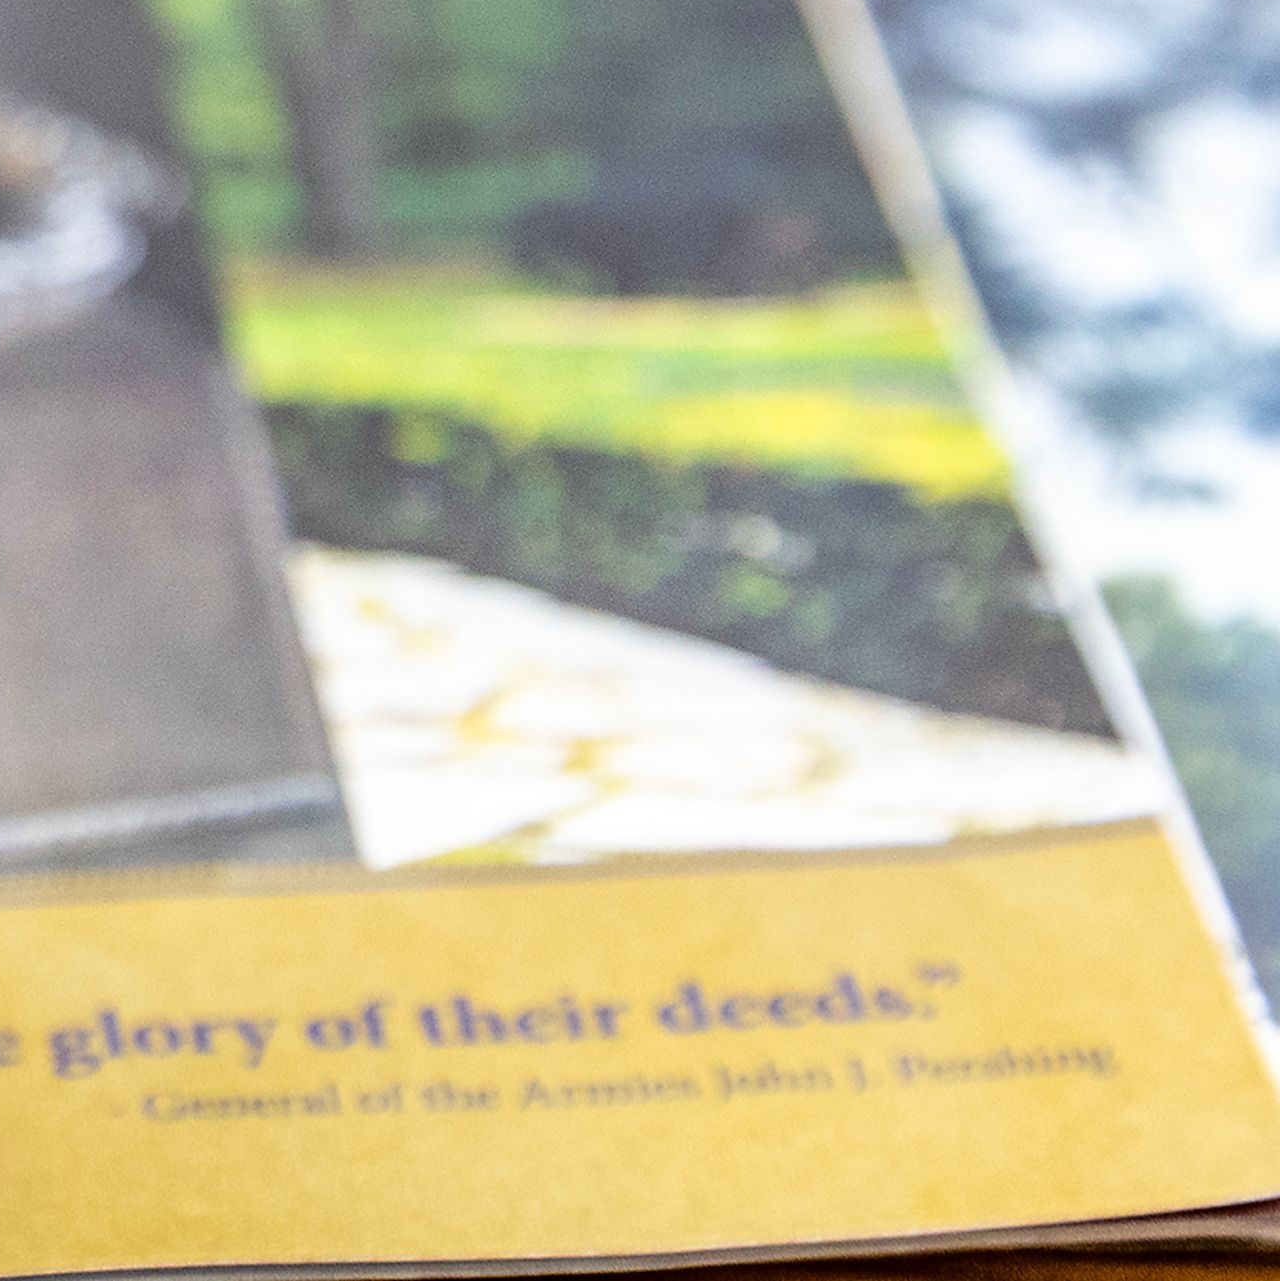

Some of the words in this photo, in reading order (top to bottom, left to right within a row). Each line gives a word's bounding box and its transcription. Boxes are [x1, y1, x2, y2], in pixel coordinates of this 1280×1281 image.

[49, 1004, 277, 1079] glory
[304, 992, 390, 1051] of
[418, 992, 629, 1049] their
[141, 1081, 340, 1122] General
[354, 1080, 405, 1114] of
[419, 1078, 501, 1113] the
[520, 1070, 701, 1111] Armies
[714, 1059, 834, 1103] John
